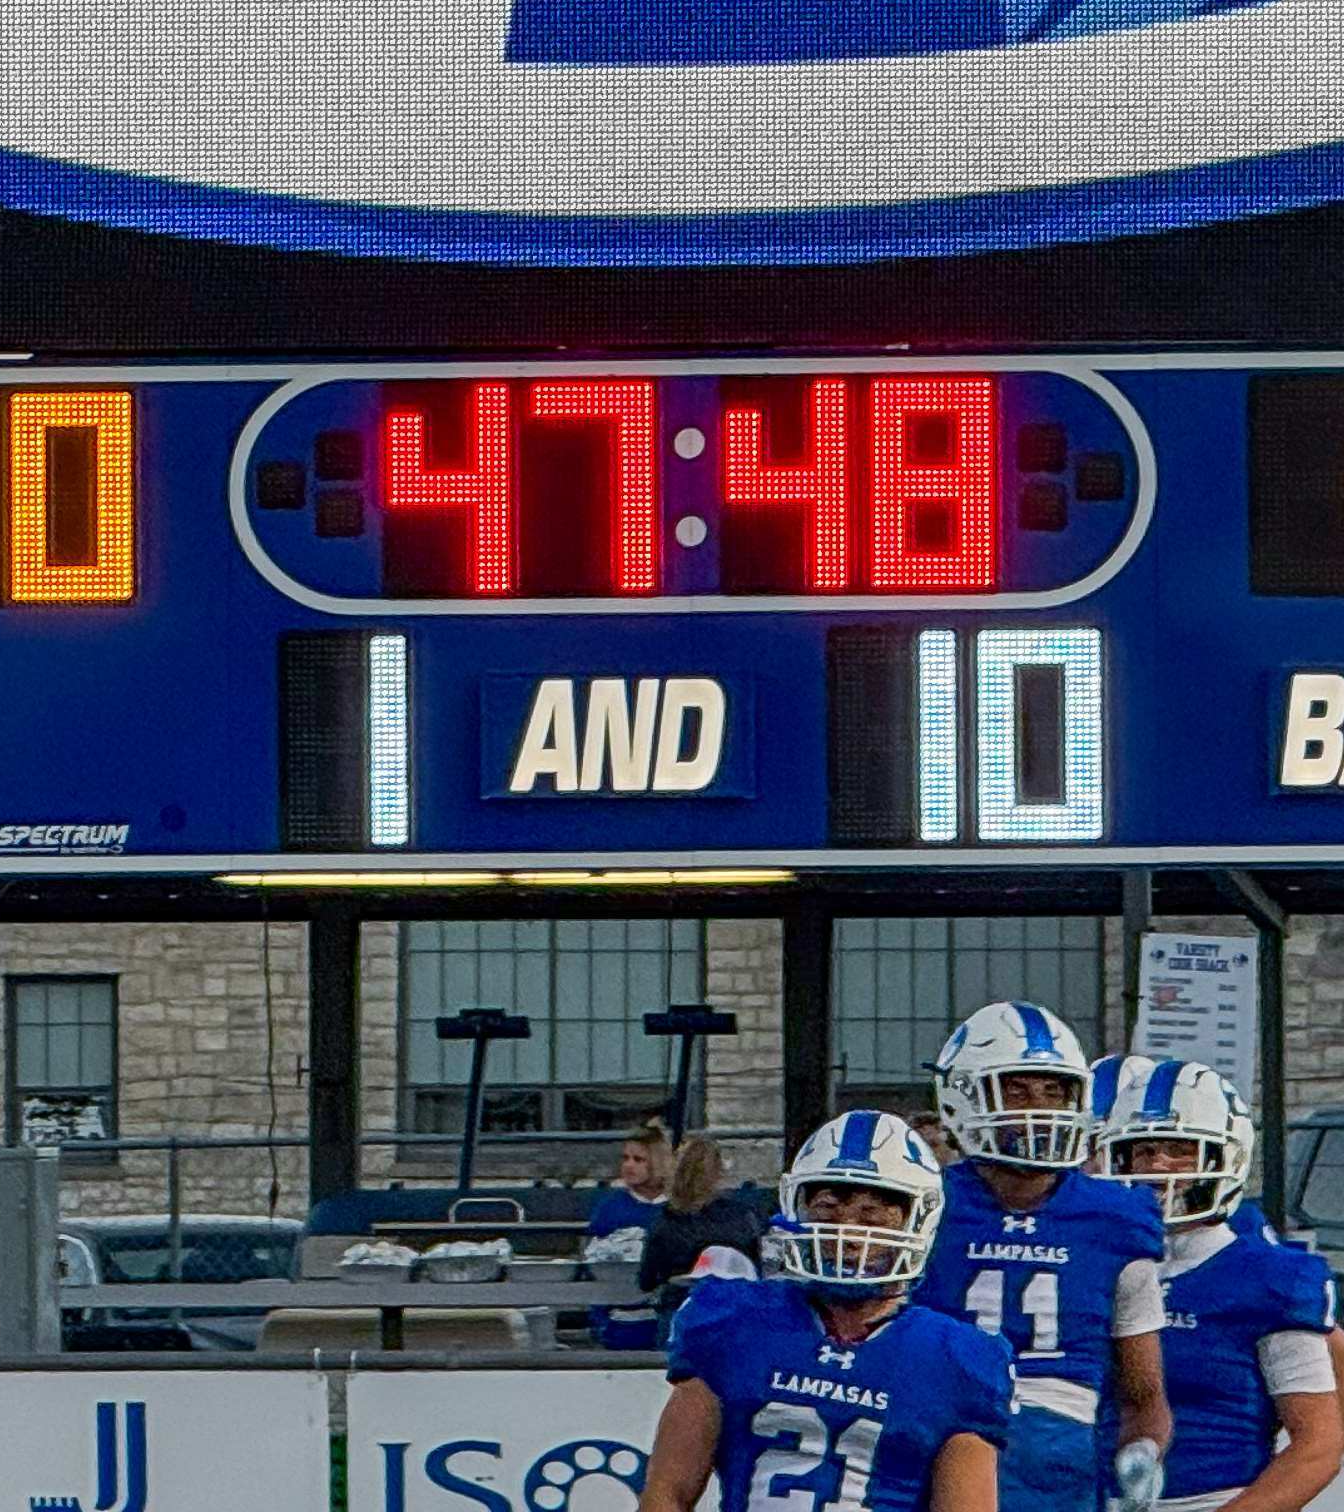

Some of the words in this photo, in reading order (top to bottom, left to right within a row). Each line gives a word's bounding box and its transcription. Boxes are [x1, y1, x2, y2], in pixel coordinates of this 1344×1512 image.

[10, 391, 134, 601] 0
[386, 376, 997, 594] 47:48
[369, 634, 409, 846] 1
[511, 678, 726, 793] AND
[919, 628, 1104, 843] 10
[967, 1241, 1070, 1265] LAMPASAS
[965, 1269, 1066, 1360] 11
[771, 1371, 889, 1411] LAMPASAS
[748, 1401, 884, 1512] 21
